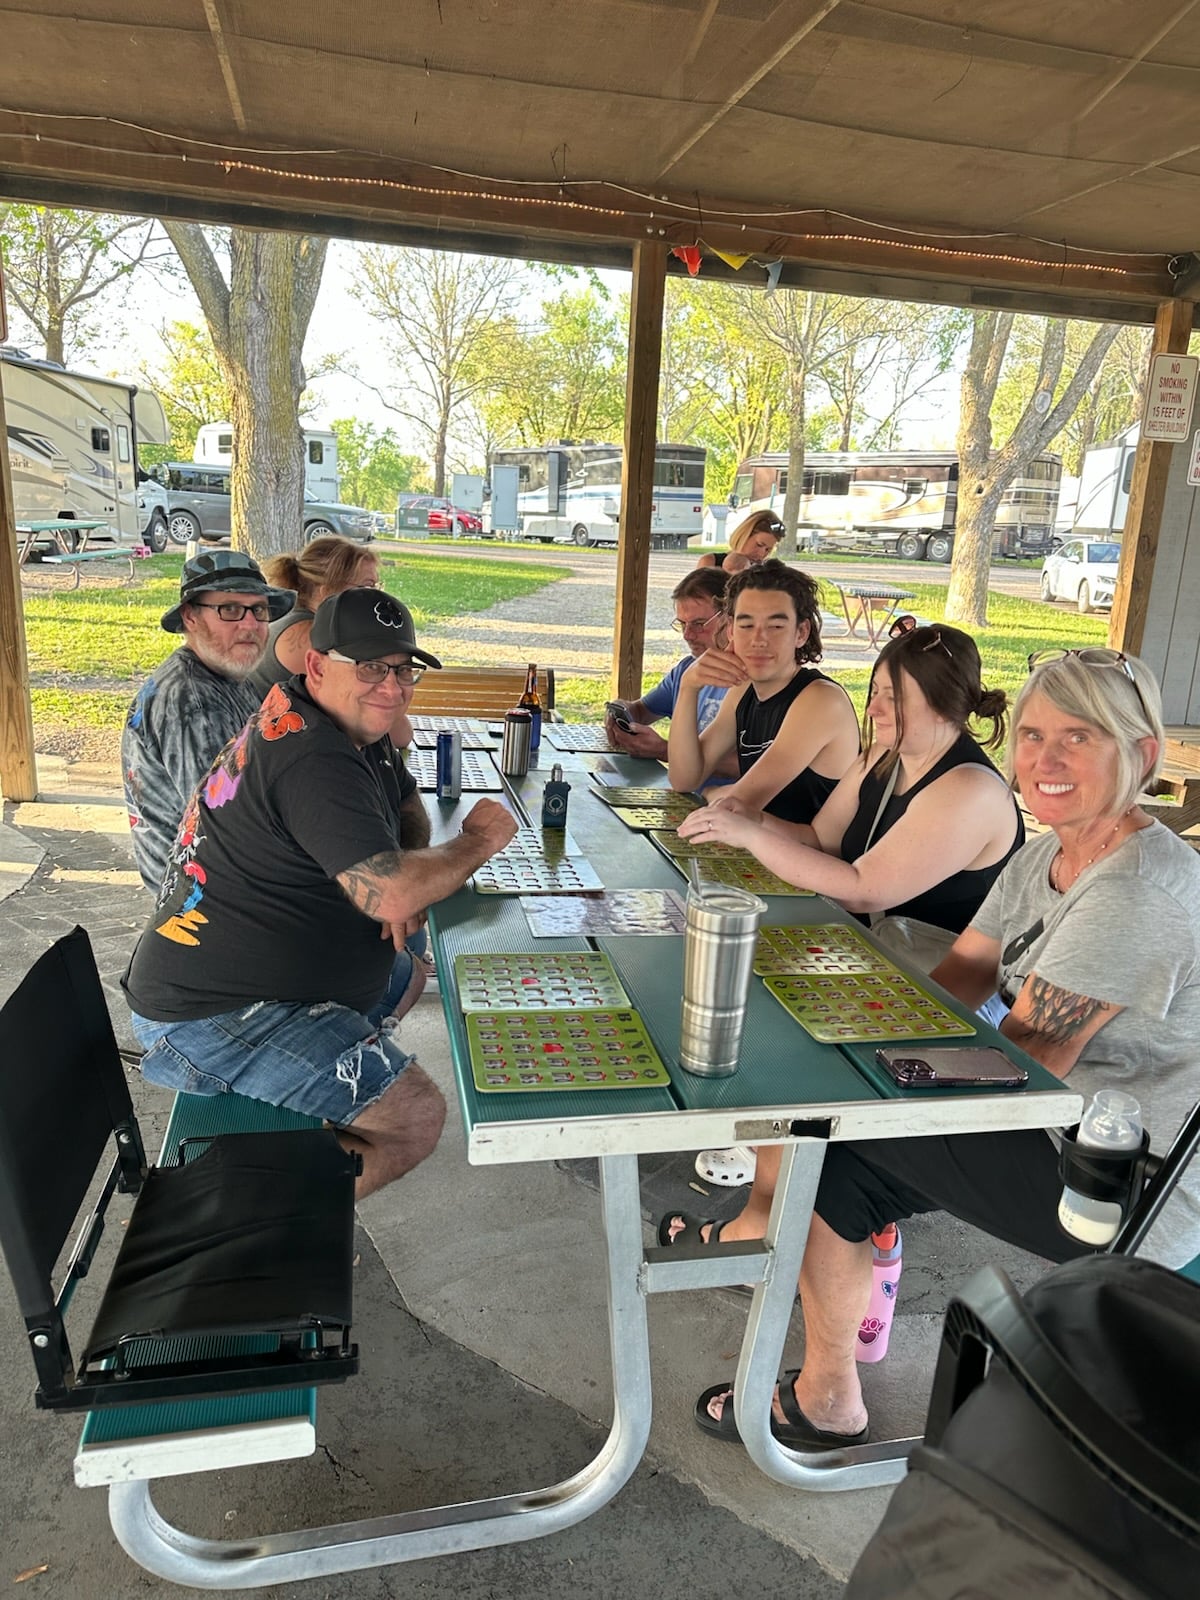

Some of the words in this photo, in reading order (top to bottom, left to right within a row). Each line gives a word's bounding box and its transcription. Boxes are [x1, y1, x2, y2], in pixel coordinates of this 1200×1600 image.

[1171, 362, 1181, 374] NO
[1159, 377, 1188, 390] SMOKING
[1160, 392, 1183, 404] WITHIN
[1152, 406, 1160, 417] 15
[1161, 407, 1177, 418] FEET
[1177, 408, 1186, 419] OF
